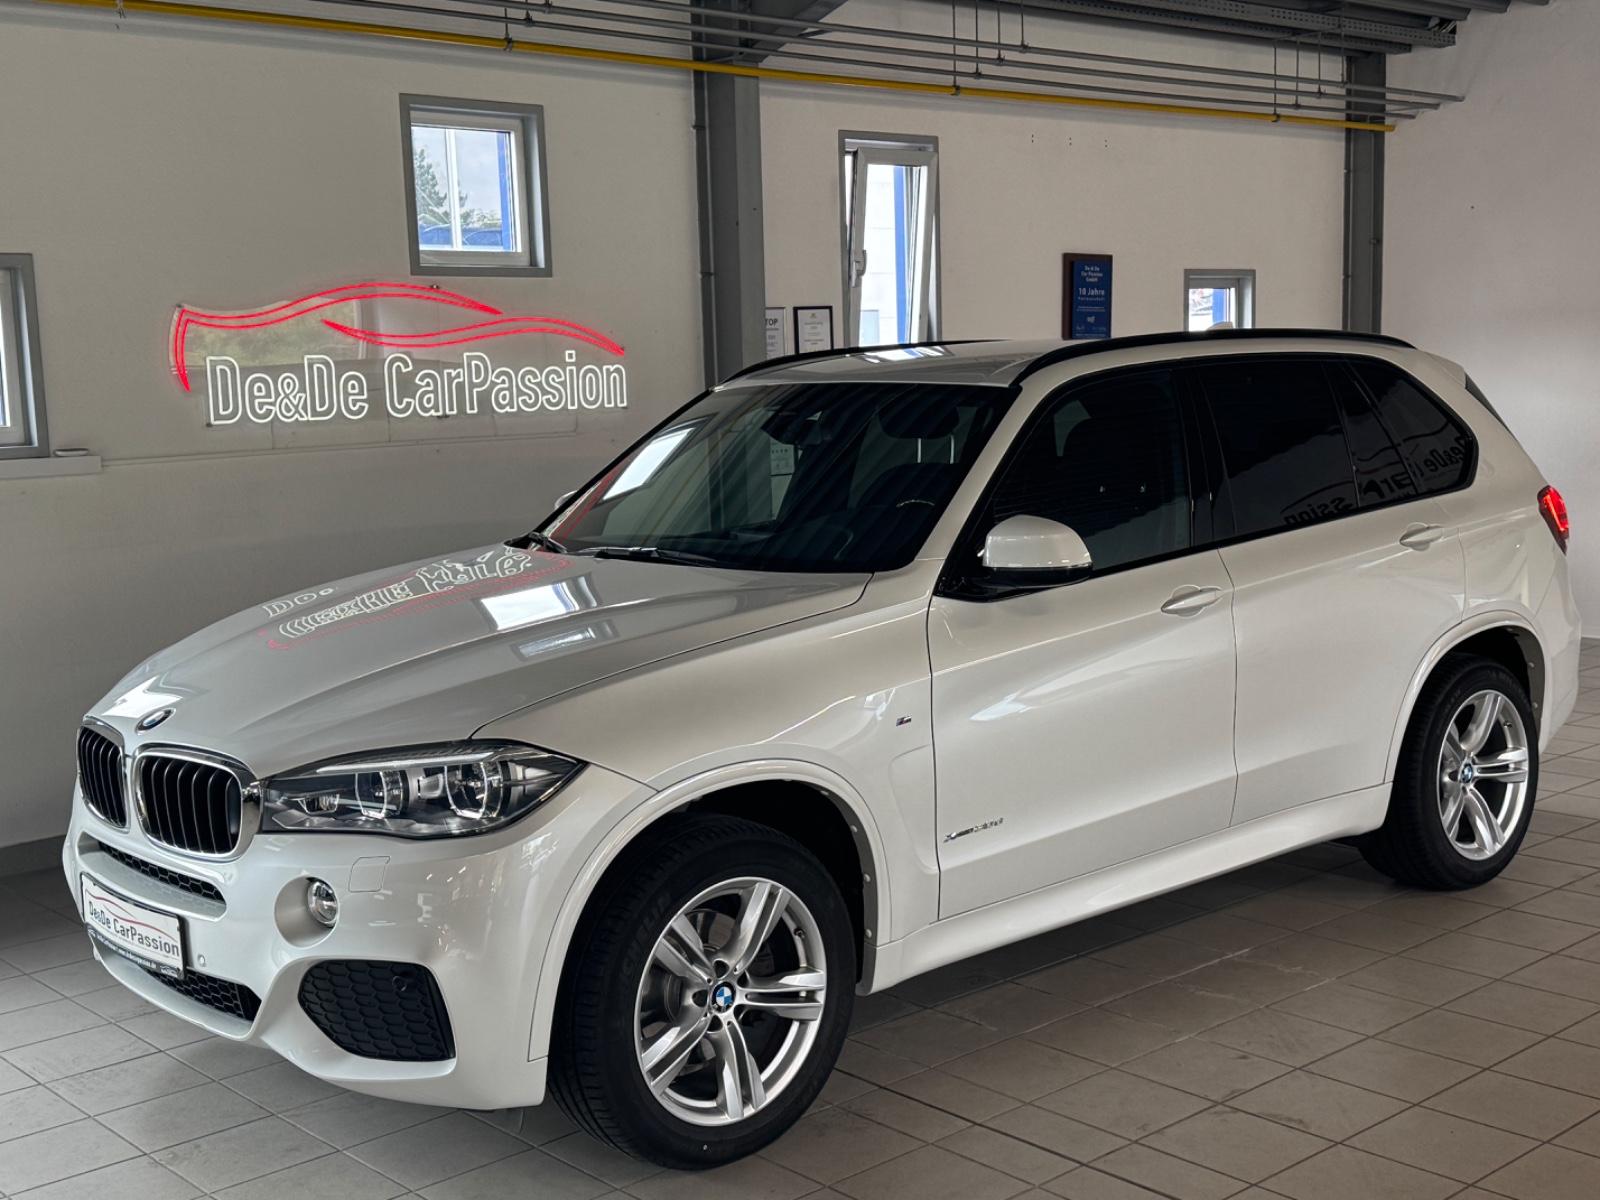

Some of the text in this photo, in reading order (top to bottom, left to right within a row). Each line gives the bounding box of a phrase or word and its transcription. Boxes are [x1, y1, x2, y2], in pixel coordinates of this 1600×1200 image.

[1087, 287, 1105, 296] Jahre
[205, 350, 628, 426] De&De CarPassion
[113, 918, 180, 957] CarPassion
